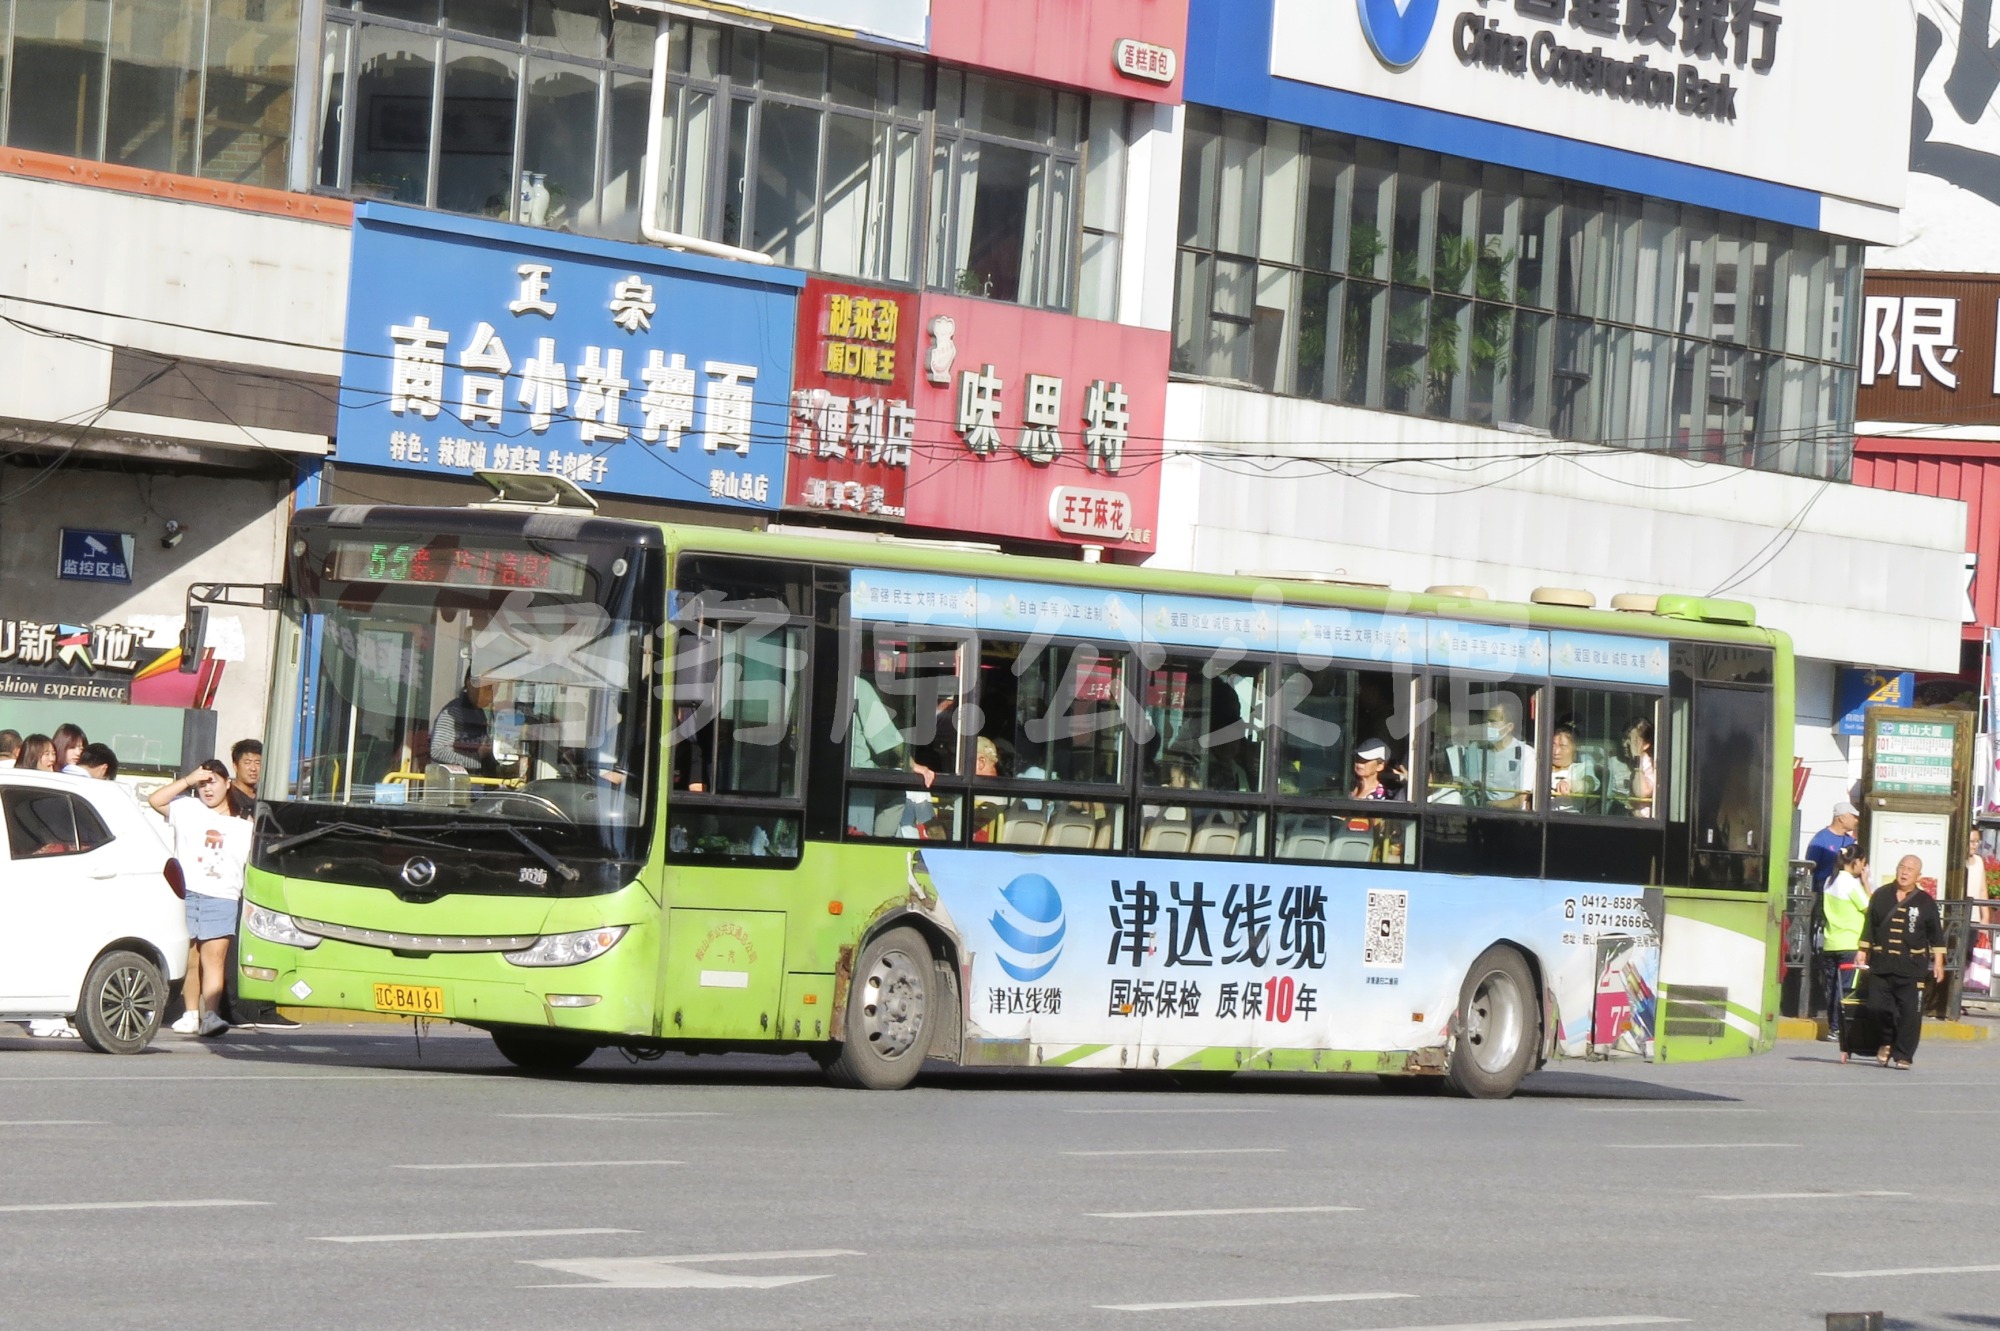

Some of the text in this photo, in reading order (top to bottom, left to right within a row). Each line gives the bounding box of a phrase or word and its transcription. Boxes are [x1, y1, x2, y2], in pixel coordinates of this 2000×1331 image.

[1124, 44, 1168, 76] 蛋糕面包
[1453, 12, 1737, 120] China Construction Bank
[509, 264, 656, 332] 正宗
[1861, 296, 1959, 389] 限
[818, 395, 916, 466] 便利店
[955, 364, 1129, 473] 味思特
[438, 436, 487, 469] 辣椒油
[493, 443, 541, 472] 炒鸡架
[709, 469, 769, 503] 鞍山总店
[1063, 496, 1124, 530] 王子麻花
[63, 559, 127, 578] 监控区域
[870, 588, 957, 609] 富强 民主 文明 和谐
[1877, 738, 1889, 750] 101
[1899, 723, 1942, 737] 鞍山大厦
[1876, 765, 1888, 778] 103
[519, 868, 547, 885] 黄海
[1107, 880, 1328, 969] 津达线缆
[988, 986, 1062, 1015] 津达线缆
[1108, 976, 1318, 1023] 国标保检 质保10年
